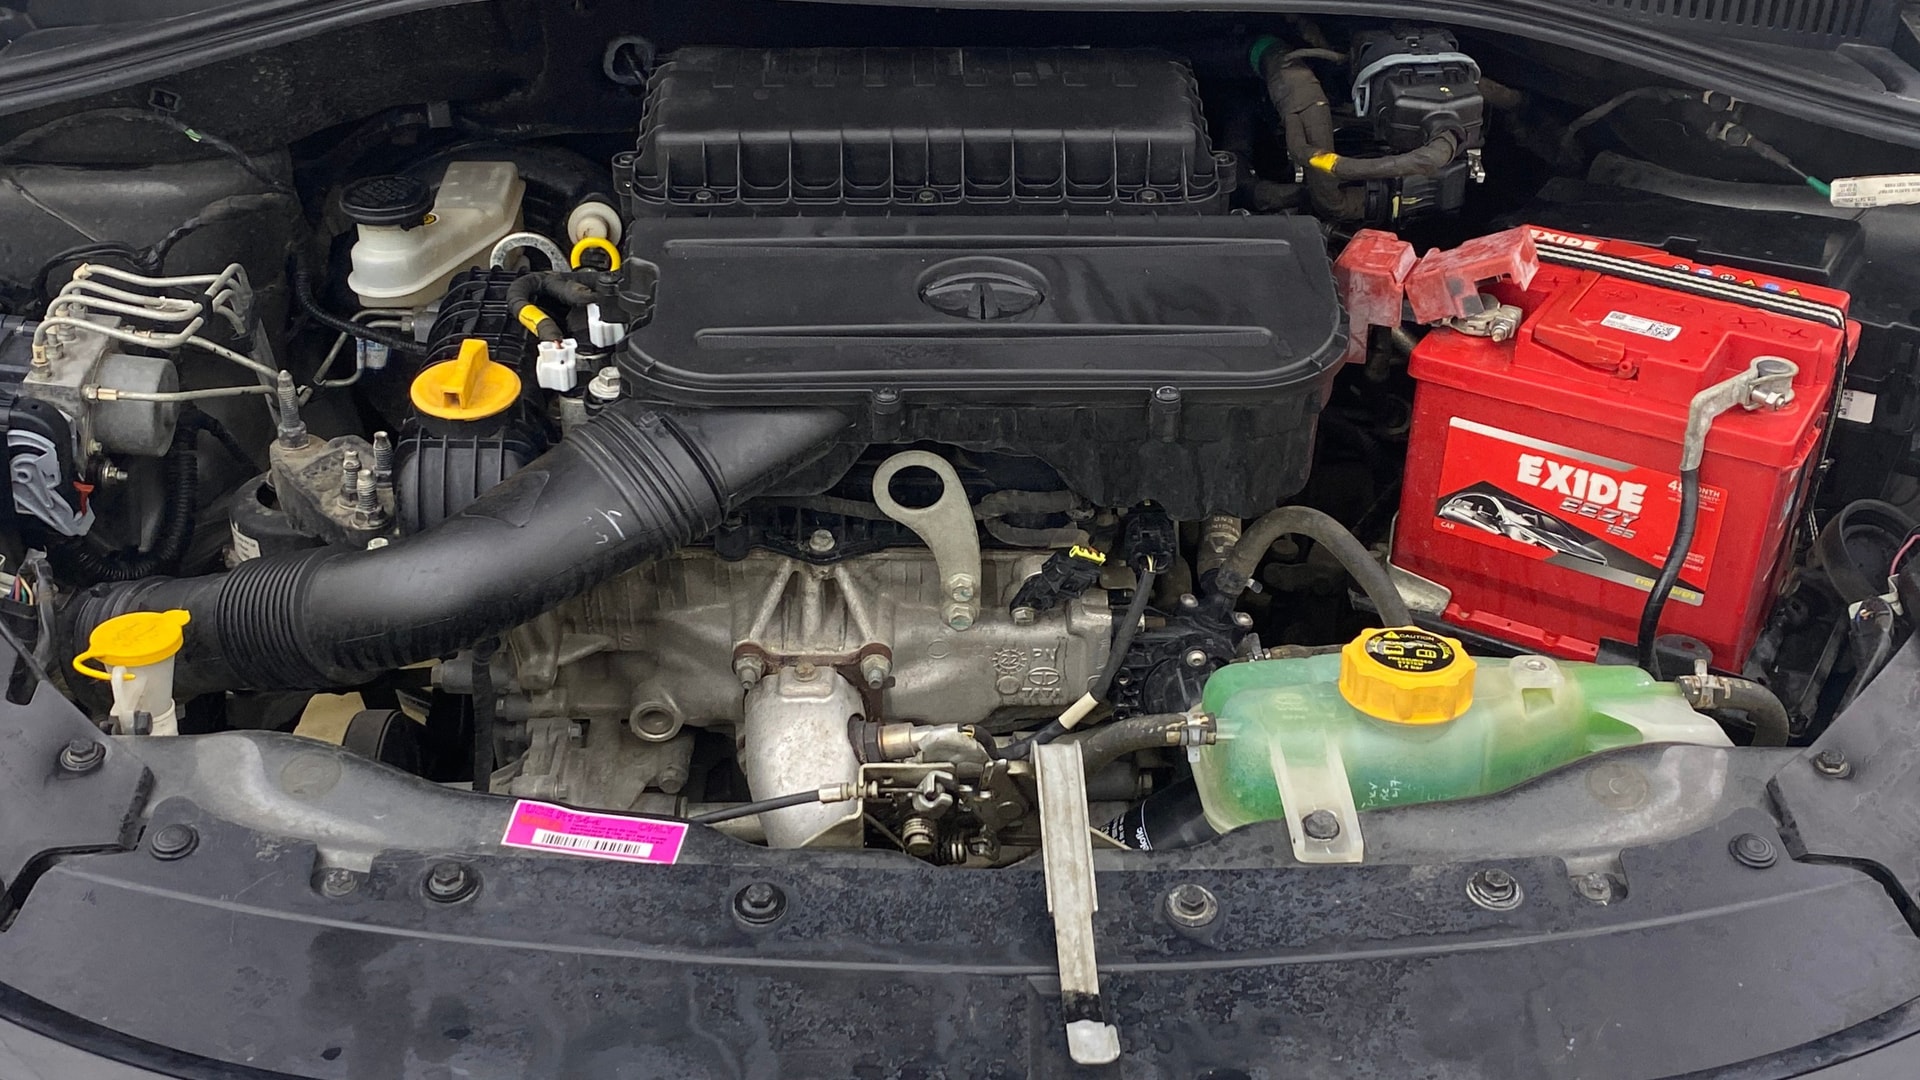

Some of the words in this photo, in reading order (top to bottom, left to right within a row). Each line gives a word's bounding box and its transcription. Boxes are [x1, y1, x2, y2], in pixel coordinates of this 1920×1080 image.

[1517, 453, 1648, 513] EXIDE
[1559, 497, 1641, 528] EEZY
[1440, 521, 1455, 530] CAR
[1400, 633, 1434, 641] CAUTION
